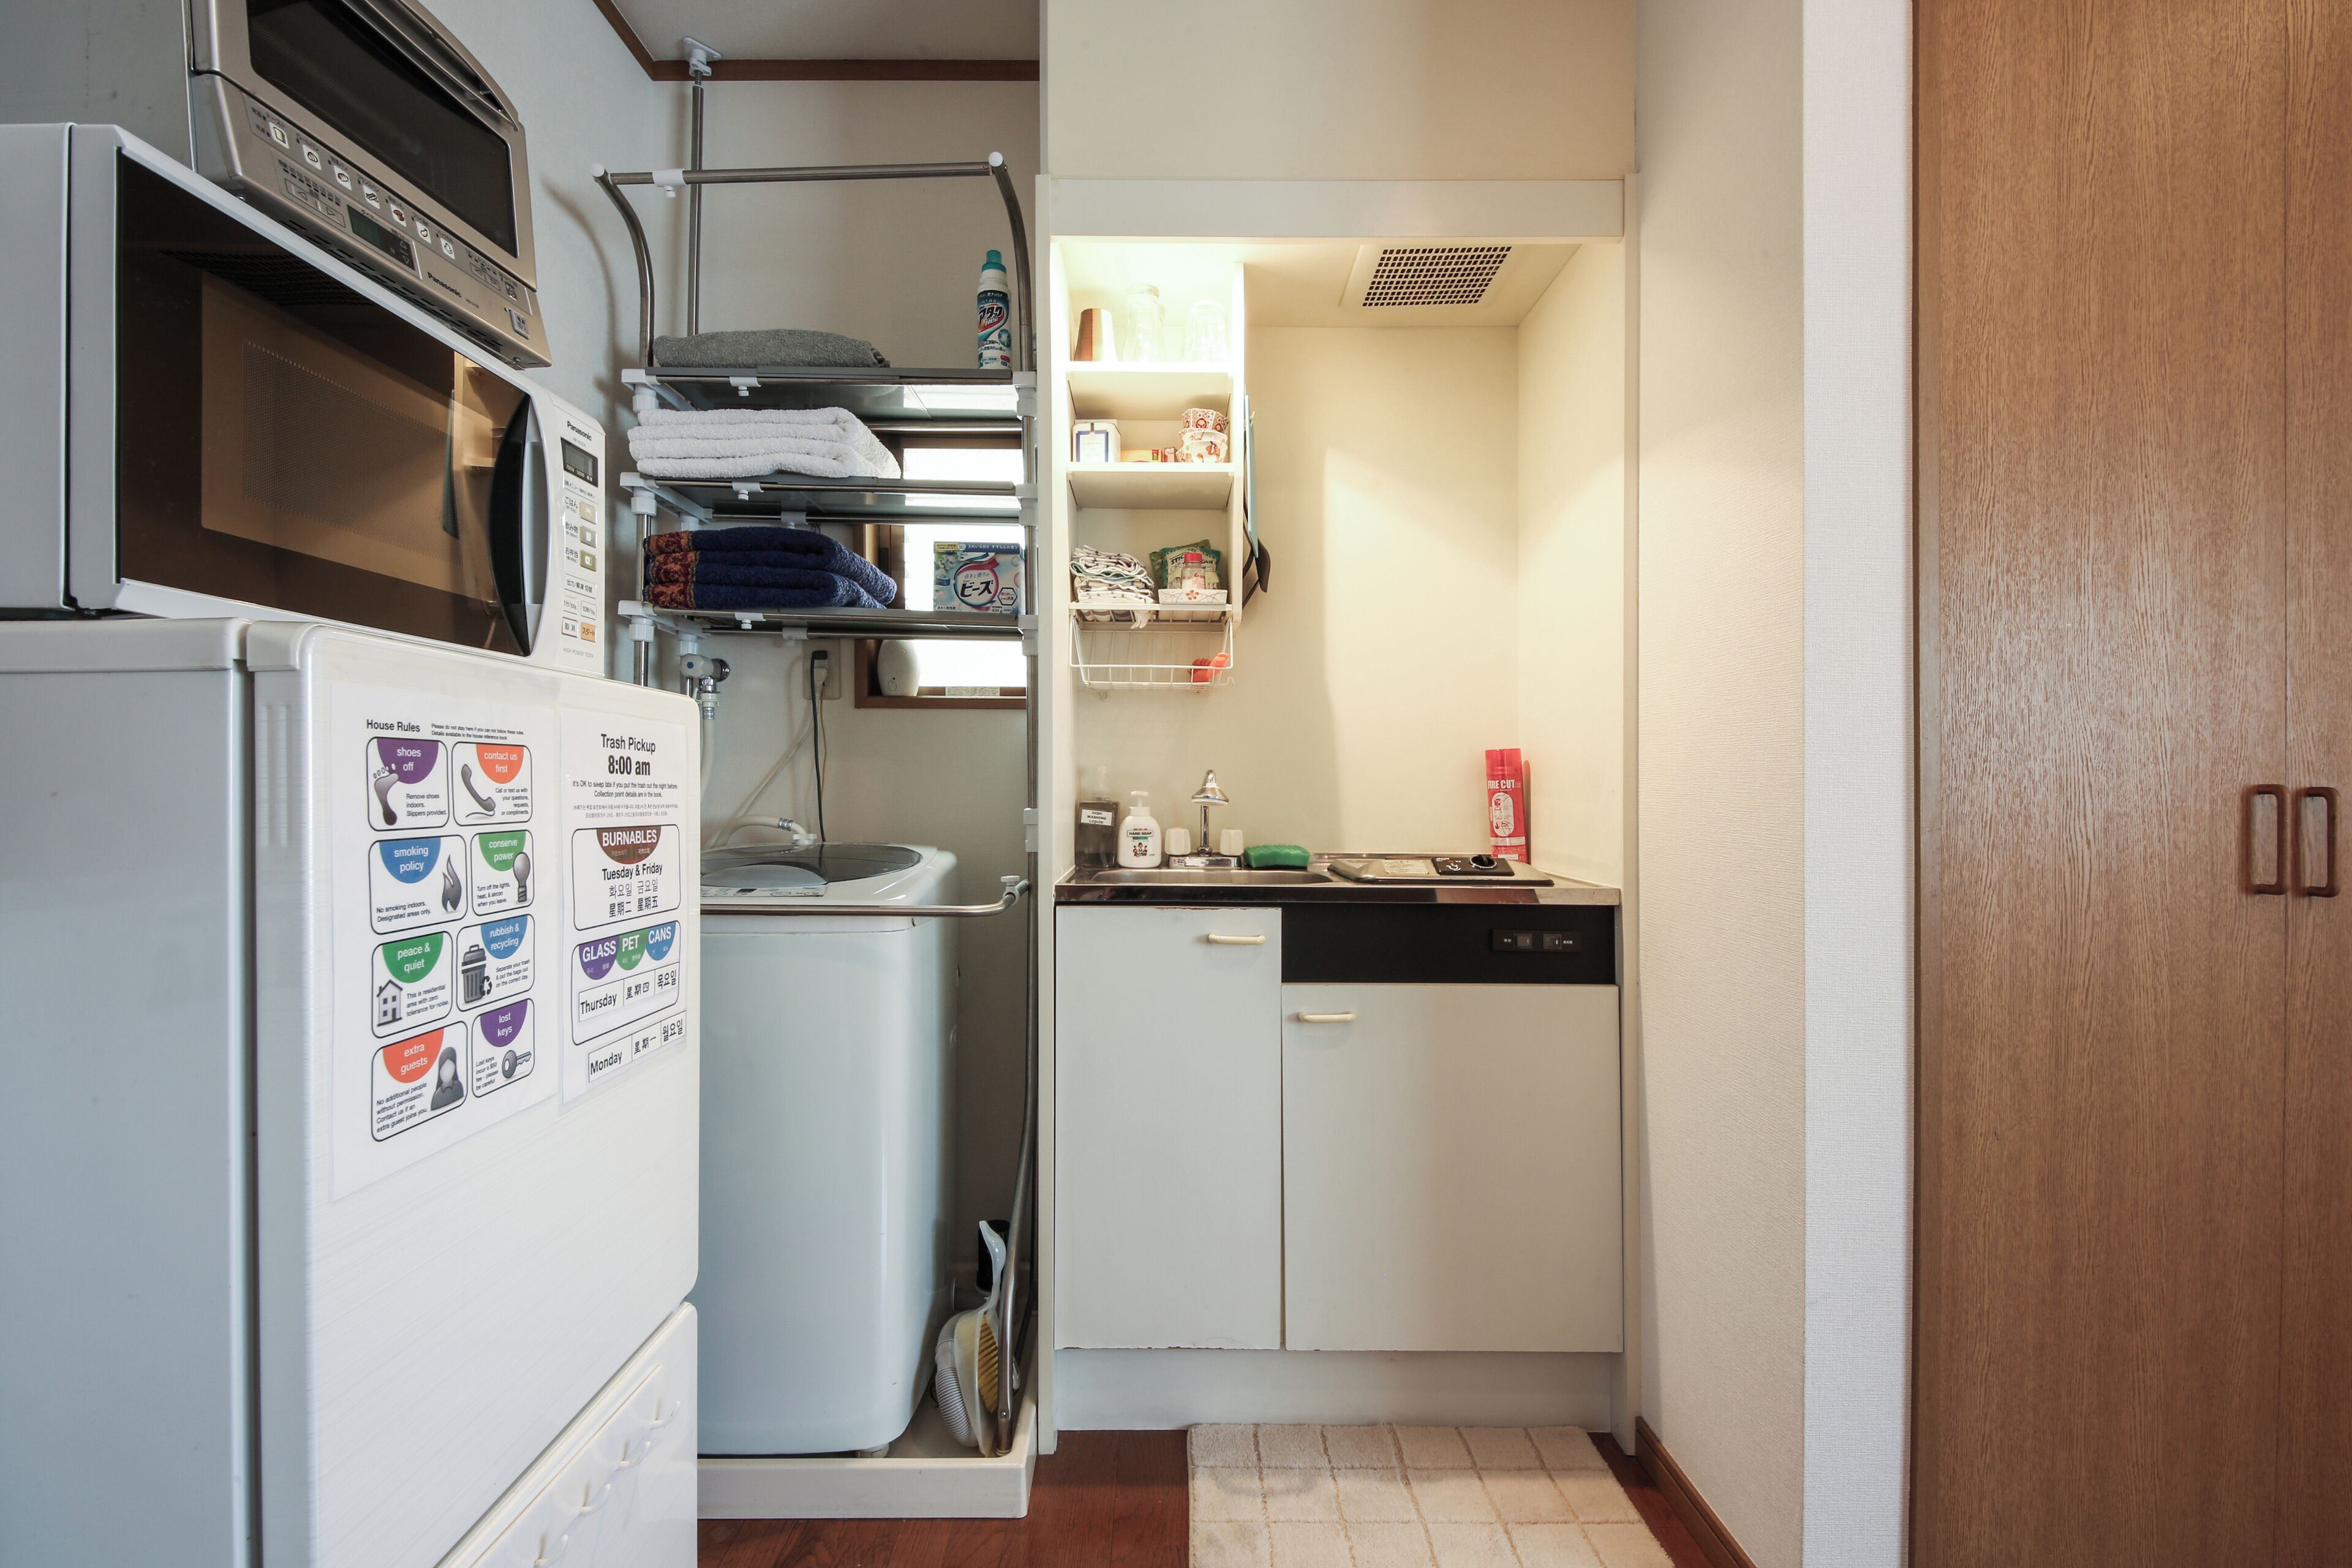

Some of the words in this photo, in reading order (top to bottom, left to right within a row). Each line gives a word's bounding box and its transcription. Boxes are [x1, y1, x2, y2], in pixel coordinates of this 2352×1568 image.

[428, 271, 462, 298] Panasonic
[567, 420, 592, 441] Panasonic
[1171, 554, 1184, 565] STIC
[960, 580, 993, 598] ビーズ
[582, 627, 595, 636] スタート
[367, 719, 394, 730] House
[397, 722, 420, 732] Rules
[601, 734, 625, 750] Trash
[628, 737, 656, 755] Pickup
[397, 747, 421, 757] shoes
[484, 752, 508, 760] contact
[403, 762, 414, 771] off
[496, 764, 508, 773] first
[608, 755, 632, 775] 8:00
[635, 760, 650, 775] am
[1488, 780, 1499, 790] FIRE
[1501, 779, 1515, 790] CUT
[489, 839, 518, 848] conserve
[602, 829, 657, 846] BURNABLES
[394, 846, 429, 858] smoking
[494, 853, 514, 862] power
[400, 861, 424, 874] policy
[602, 865, 634, 880] Tuesday
[635, 864, 640, 876] &
[643, 862, 663, 875] Friday
[609, 882, 632, 899] 화요일
[638, 878, 658, 894] 금요일
[385, 904, 406, 913] smoking
[609, 902, 631, 918] 星期二
[638, 895, 658, 911] 星期五
[377, 913, 405, 922] Designated
[490, 925, 513, 937] rubbish
[514, 923, 519, 932] &
[491, 937, 519, 951] recycling
[582, 940, 616, 962] GLASS
[622, 935, 640, 952] PET
[648, 926, 671, 944] CANS
[398, 946, 423, 960] peace
[424, 943, 431, 952] &
[404, 959, 425, 973] quiet
[496, 964, 512, 973] Separate
[657, 969, 676, 990] 목요일
[423, 984, 446, 995] residential
[626, 982, 649, 1000] 星期四
[580, 993, 617, 1014] Thursday
[407, 1006, 428, 1017] tolerance
[499, 1012, 511, 1023] lost
[497, 1025, 513, 1038] keys
[663, 1019, 683, 1042] 월요일
[404, 1044, 425, 1057] extra
[634, 1036, 657, 1055] 星期一
[401, 1057, 428, 1076] guests
[590, 1051, 622, 1075] Monday
[385, 1088, 410, 1104] additional
[411, 1082, 428, 1094] people
[377, 1103, 396, 1115] without
[396, 1092, 424, 1108] permission.
[377, 1112, 397, 1124] Contact
[377, 1124, 390, 1133] extra
[391, 1117, 405, 1128] guest
[405, 1110, 417, 1121] joins
[418, 1107, 428, 1116] you.
